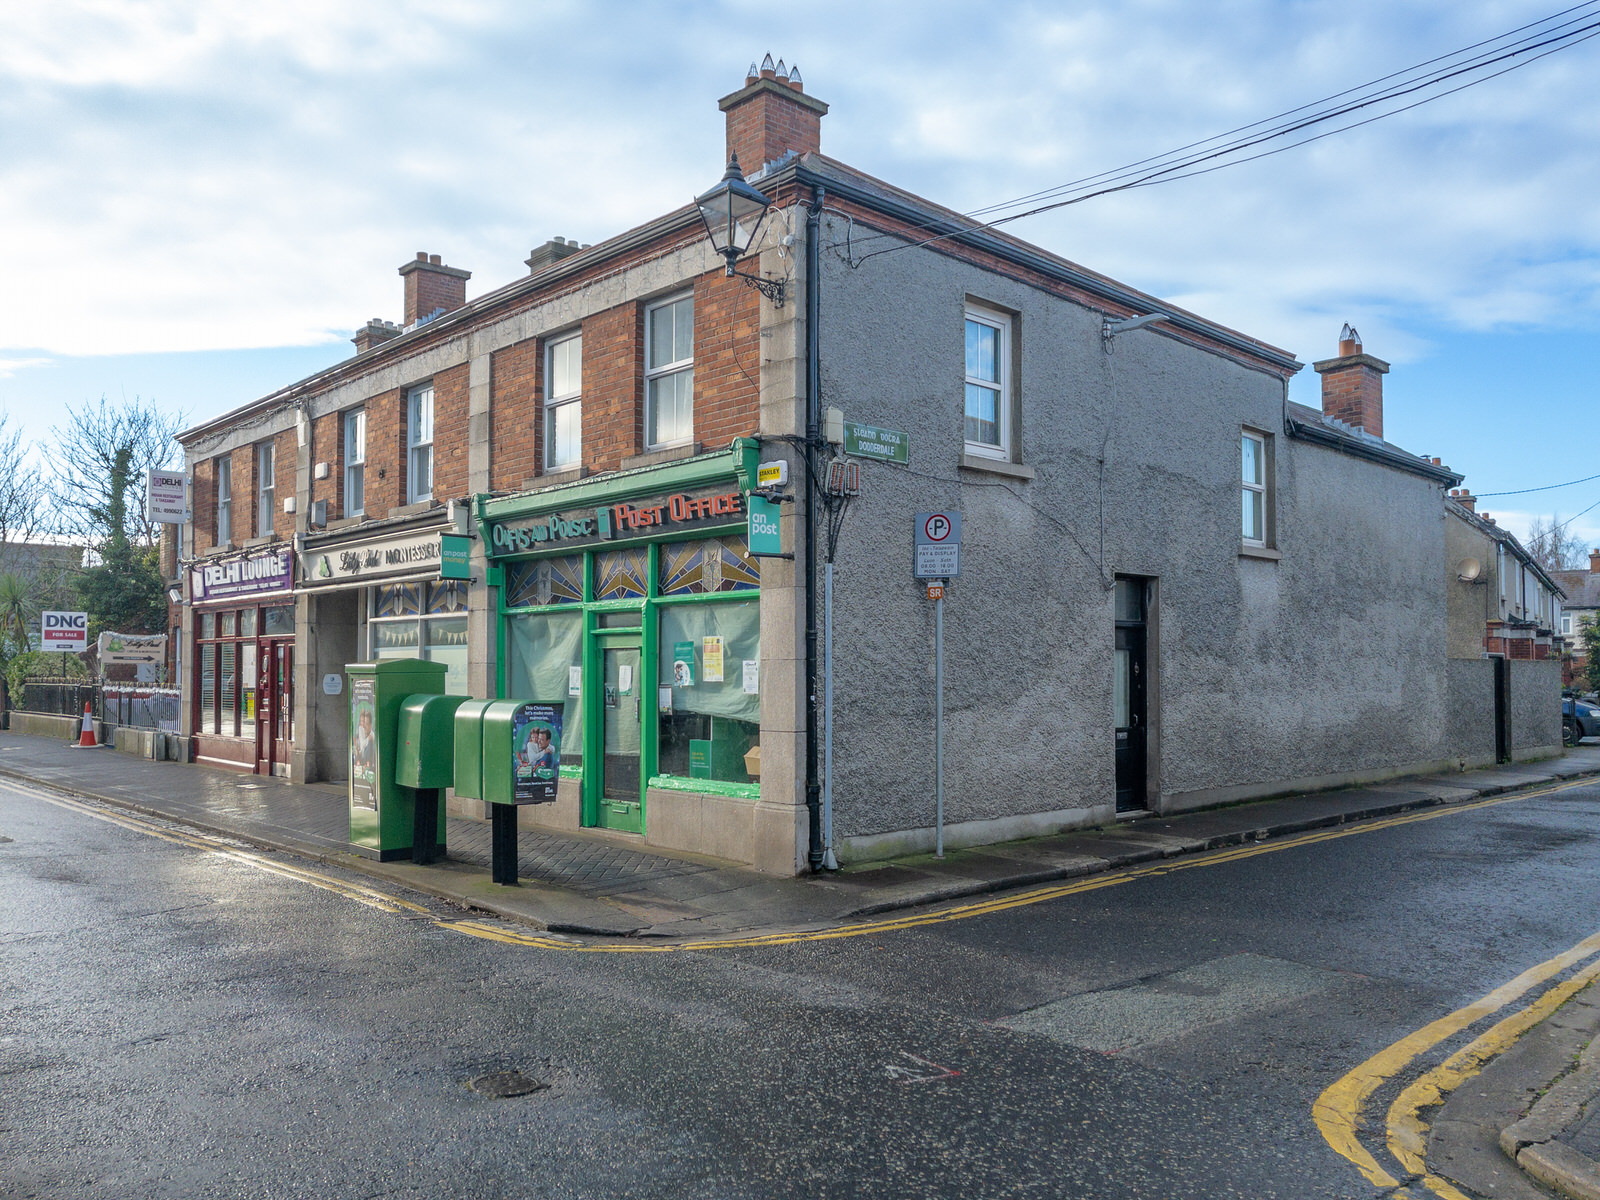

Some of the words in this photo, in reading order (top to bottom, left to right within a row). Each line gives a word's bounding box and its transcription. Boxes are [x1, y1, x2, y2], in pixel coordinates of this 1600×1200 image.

[859, 440, 894, 456] DODDERDALE
[759, 468, 780, 476] STANLEY
[162, 478, 181, 486] DELHI
[752, 513, 766, 523] an
[752, 523, 777, 535] post
[386, 541, 441, 565] MONTESSOR
[205, 562, 240, 587] DELHI
[242, 554, 287, 581] LOUNGE
[930, 588, 941, 597] SR
[46, 615, 85, 628] DNG
